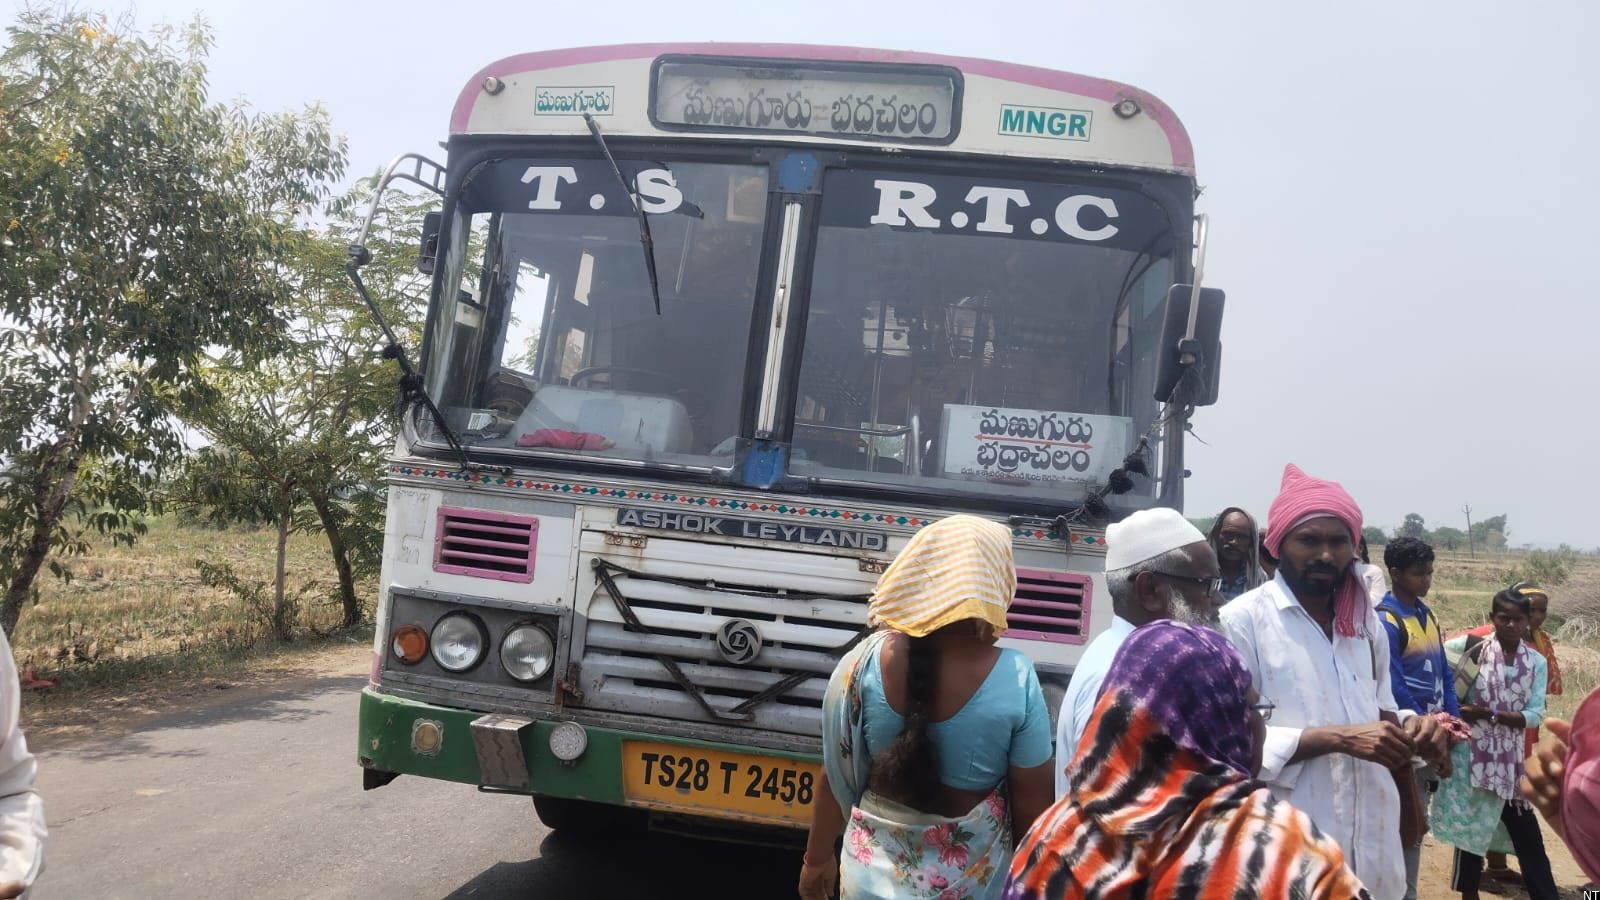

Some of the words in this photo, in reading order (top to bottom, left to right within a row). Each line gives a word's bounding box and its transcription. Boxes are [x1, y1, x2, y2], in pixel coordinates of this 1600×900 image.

[537, 90, 610, 112] మణుగూరు
[683, 88, 812, 128] మణుగూరు
[1002, 109, 1087, 137] MNGR
[870, 179, 1119, 241] R.T.C
[980, 409, 1093, 443] మణుగురు
[977, 441, 1090, 472] భద్రాచలం
[620, 509, 724, 535] ASHOK
[743, 521, 885, 550] LEYLAND
[641, 752, 710, 792] TS28
[720, 761, 738, 794] T
[745, 765, 814, 804] 2458
